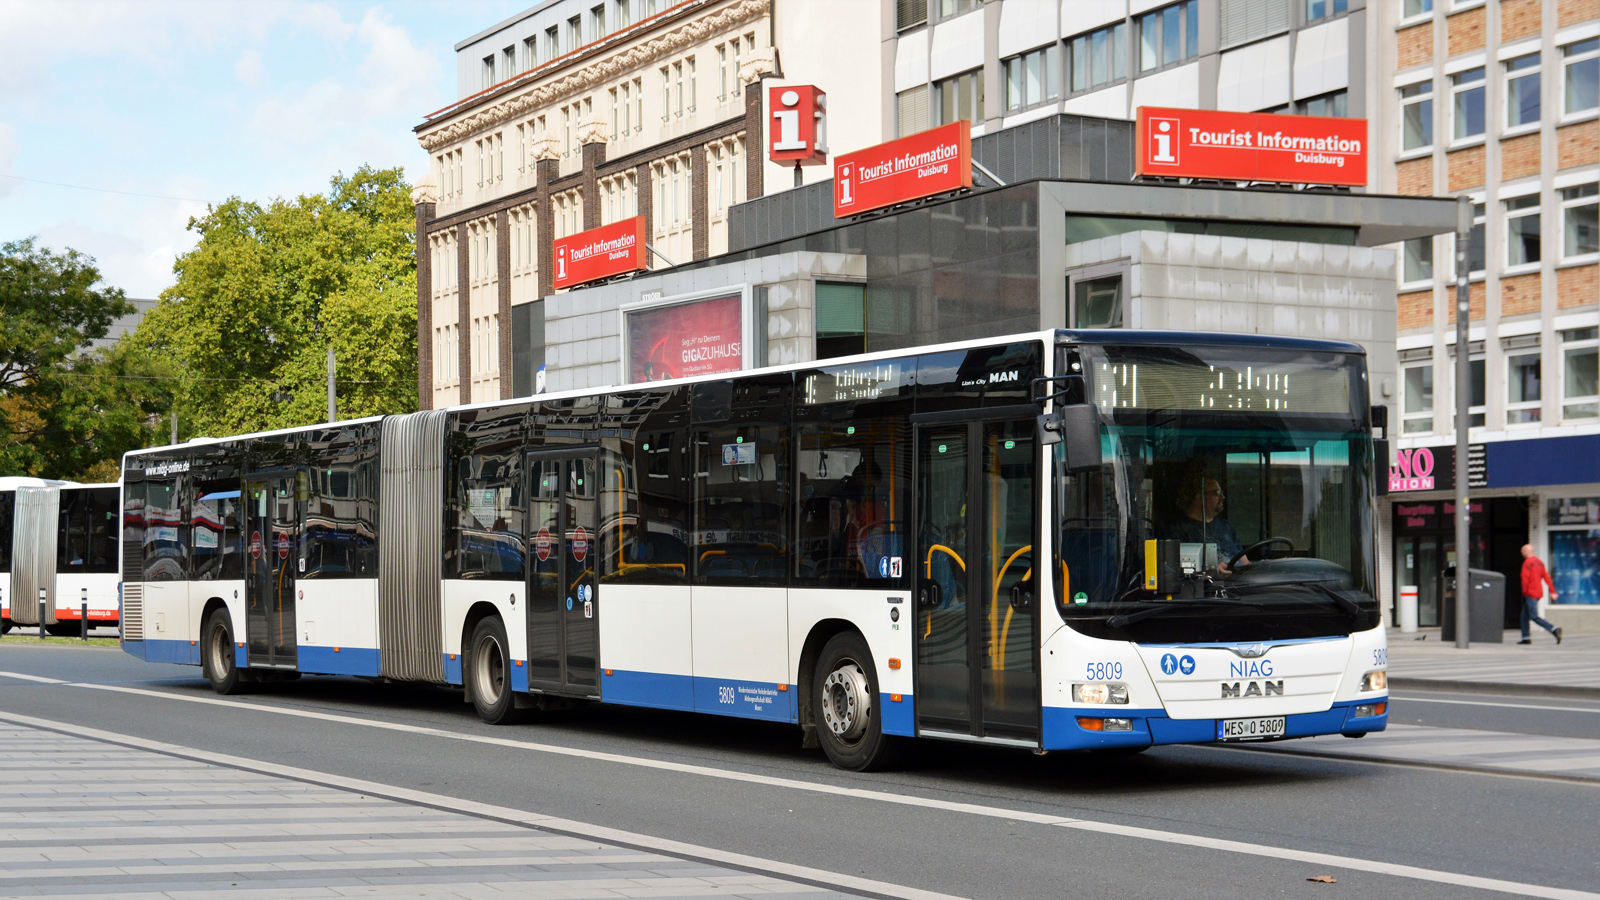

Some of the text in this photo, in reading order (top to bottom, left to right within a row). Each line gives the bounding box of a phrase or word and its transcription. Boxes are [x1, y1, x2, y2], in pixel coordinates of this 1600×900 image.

[1153, 121, 1175, 162] i
[1189, 127, 1361, 153] Tourist Information
[859, 143, 958, 182] Tourist Information
[1295, 153, 1344, 167] Duisburg
[917, 163, 948, 179] Duisburg
[840, 167, 852, 204] i
[570, 233, 635, 260] Tourist Information
[609, 249, 629, 260] Duisburg
[681, 338, 690, 347] Sag
[703, 335, 721, 343] Deinem
[682, 342, 741, 363] GIGAZUHAUSE
[989, 370, 1019, 384] MAN
[145, 460, 190, 477] www.niag-online.de
[1390, 479, 1432, 489] HION
[1086, 661, 1123, 680] 5809
[1230, 659, 1273, 678] NIAG
[719, 686, 735, 704] 5809
[1221, 680, 1284, 698] MAN
[1224, 721, 1244, 736] WES
[1259, 719, 1284, 734] 5809
